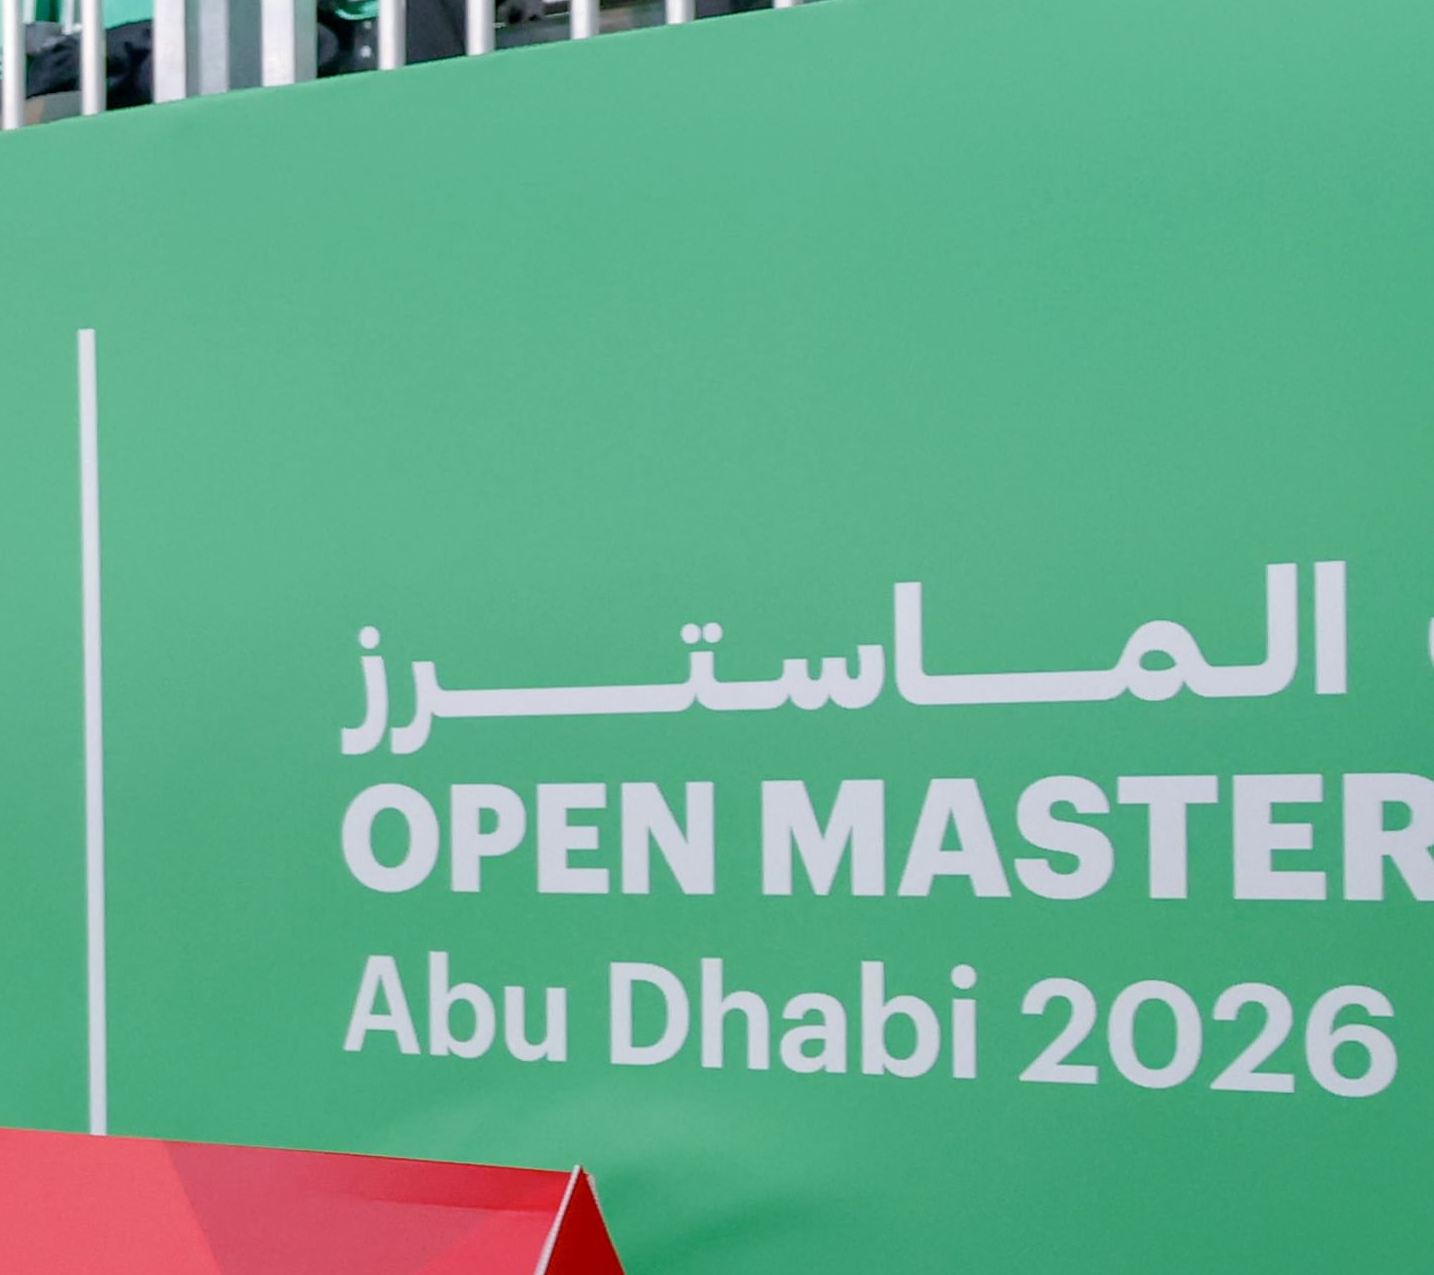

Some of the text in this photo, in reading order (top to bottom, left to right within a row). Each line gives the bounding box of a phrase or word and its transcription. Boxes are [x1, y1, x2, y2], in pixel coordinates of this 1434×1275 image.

[340, 560, 1348, 755] الماسترز
[341, 772, 1434, 901] OPEN MASTER
[343, 951, 1398, 1098] Abu Dhabi 2026
